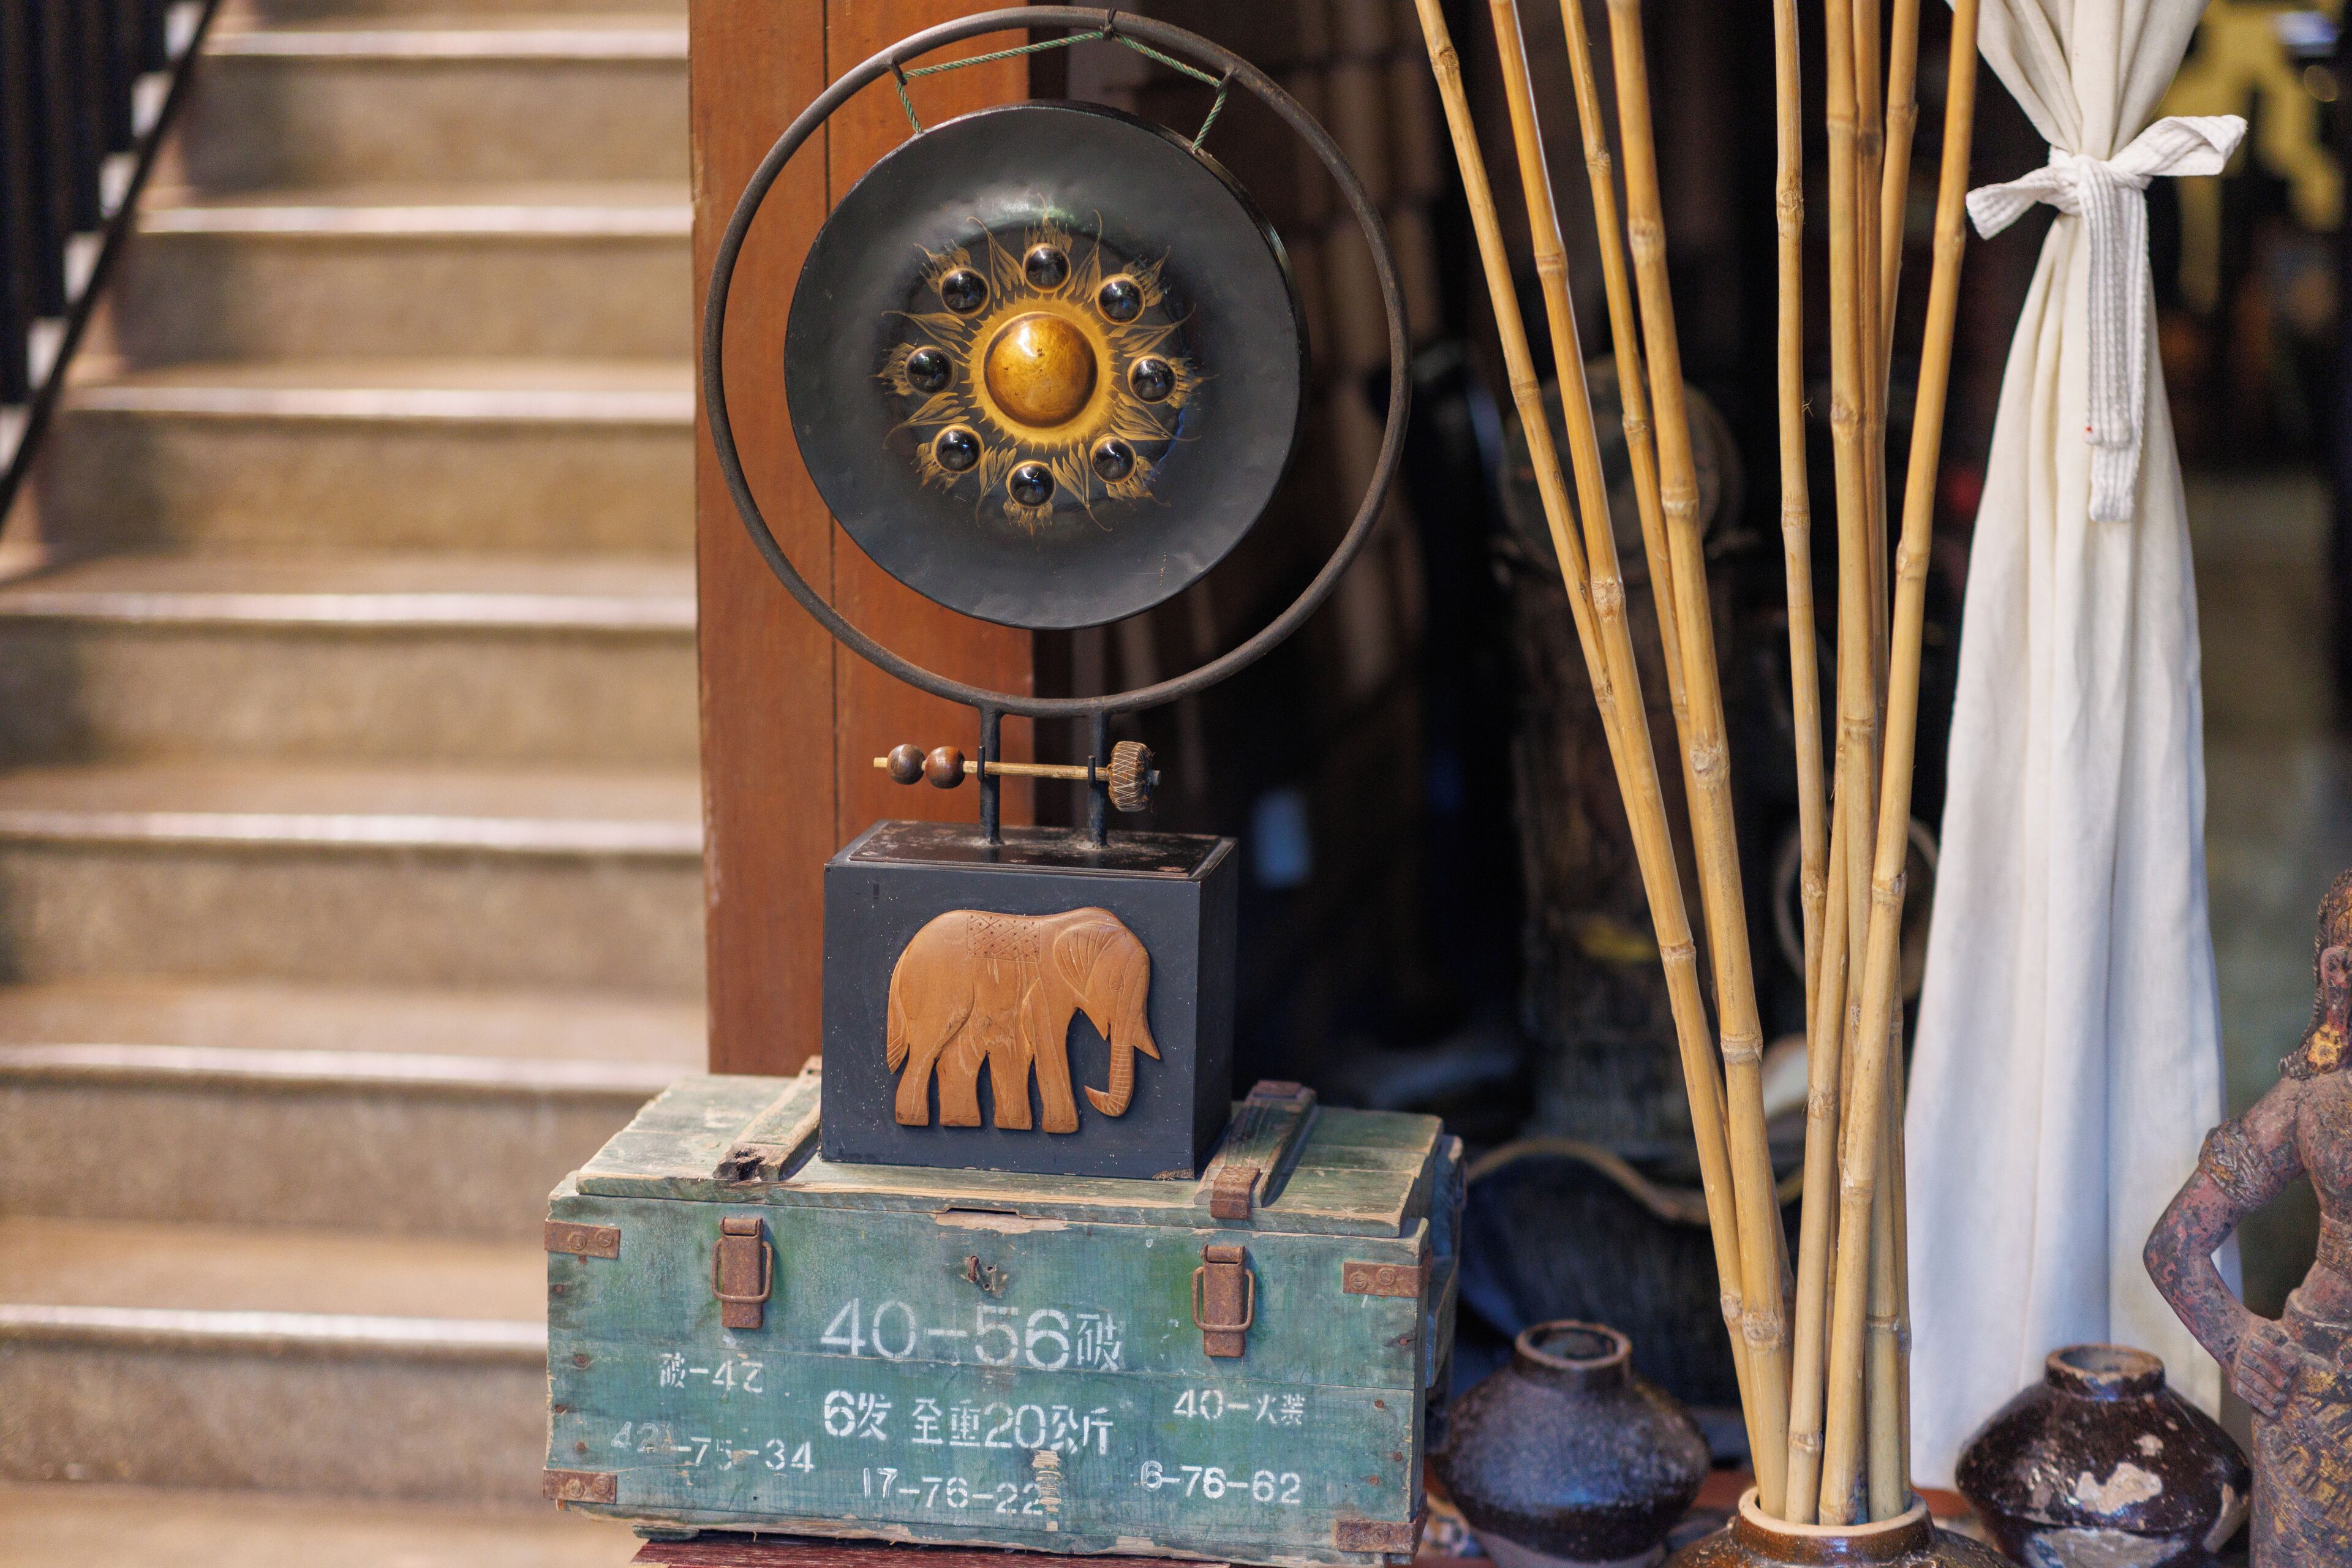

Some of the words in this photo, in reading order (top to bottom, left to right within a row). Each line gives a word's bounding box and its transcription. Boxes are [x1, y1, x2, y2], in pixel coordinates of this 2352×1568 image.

[821, 1298, 1121, 1372] 40-56破
[824, 1390, 891, 1441] 6发
[1140, 1460, 1300, 1504] 6-76-62
